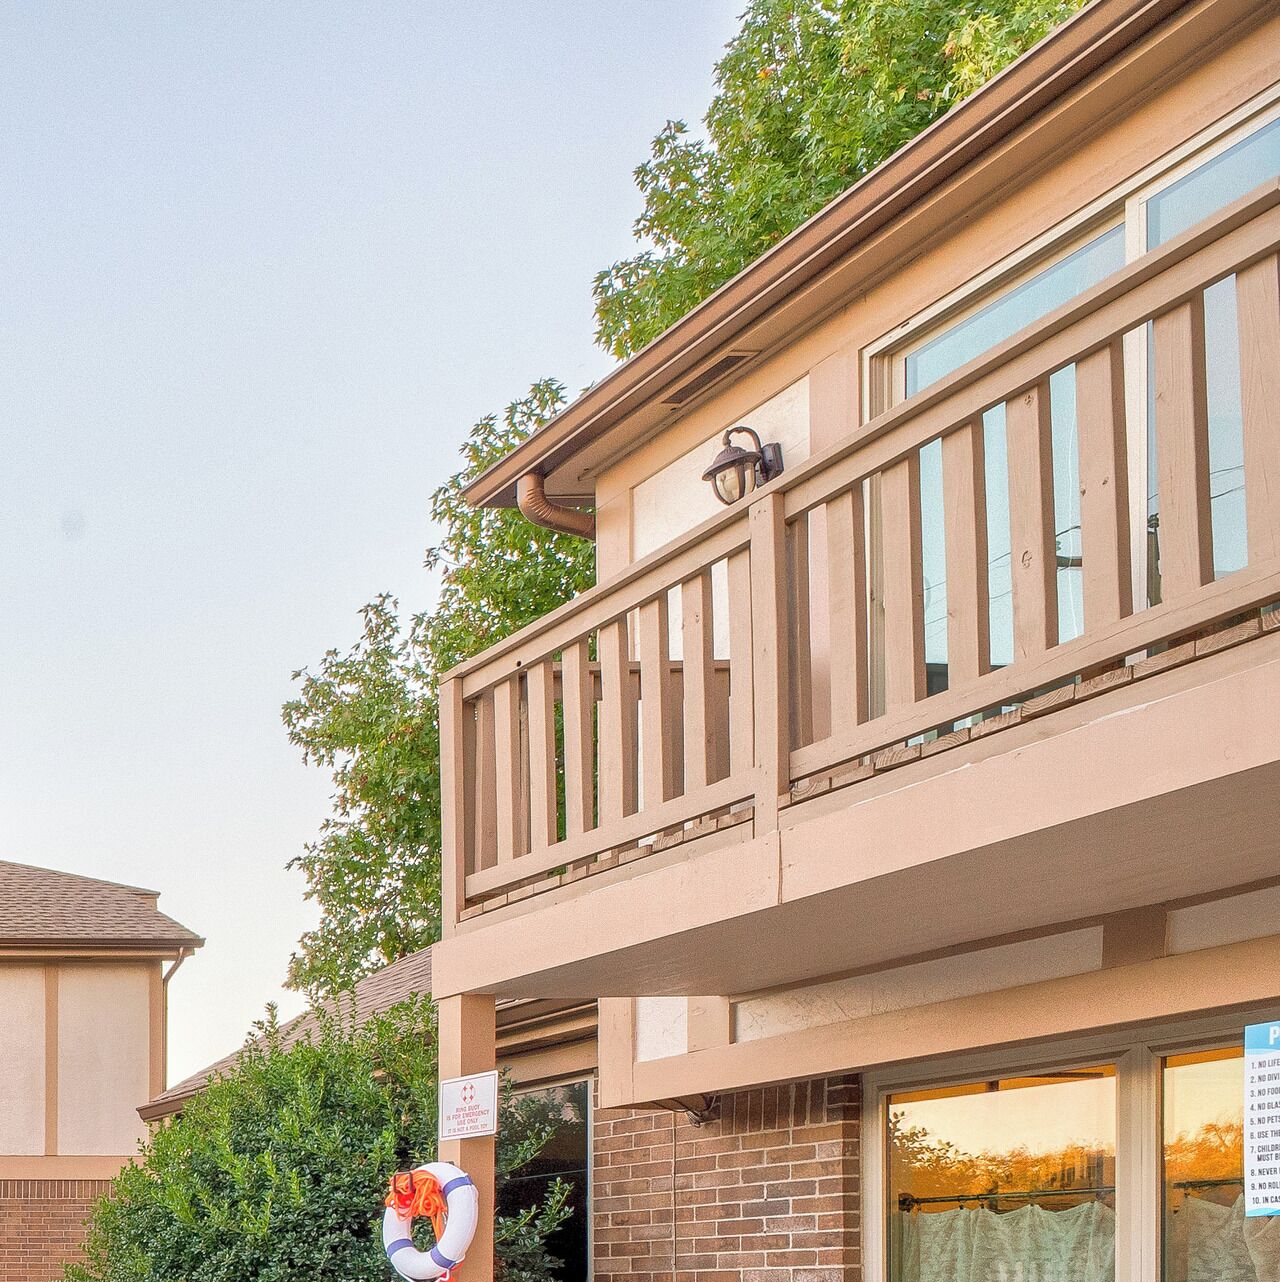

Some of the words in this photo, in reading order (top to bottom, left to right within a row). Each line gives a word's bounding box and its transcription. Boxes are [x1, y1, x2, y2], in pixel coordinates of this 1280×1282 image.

[1258, 1060, 1266, 1068] NO
[1257, 1074, 1266, 1082] NO
[1257, 1088, 1266, 1096] NO
[1257, 1102, 1266, 1110] NO
[1257, 1116, 1266, 1124] NO
[1257, 1131, 1269, 1139] USE
[1257, 1153, 1273, 1161] MUST
[1258, 1167, 1278, 1176] NEVER
[1258, 1182, 1267, 1190] NO
